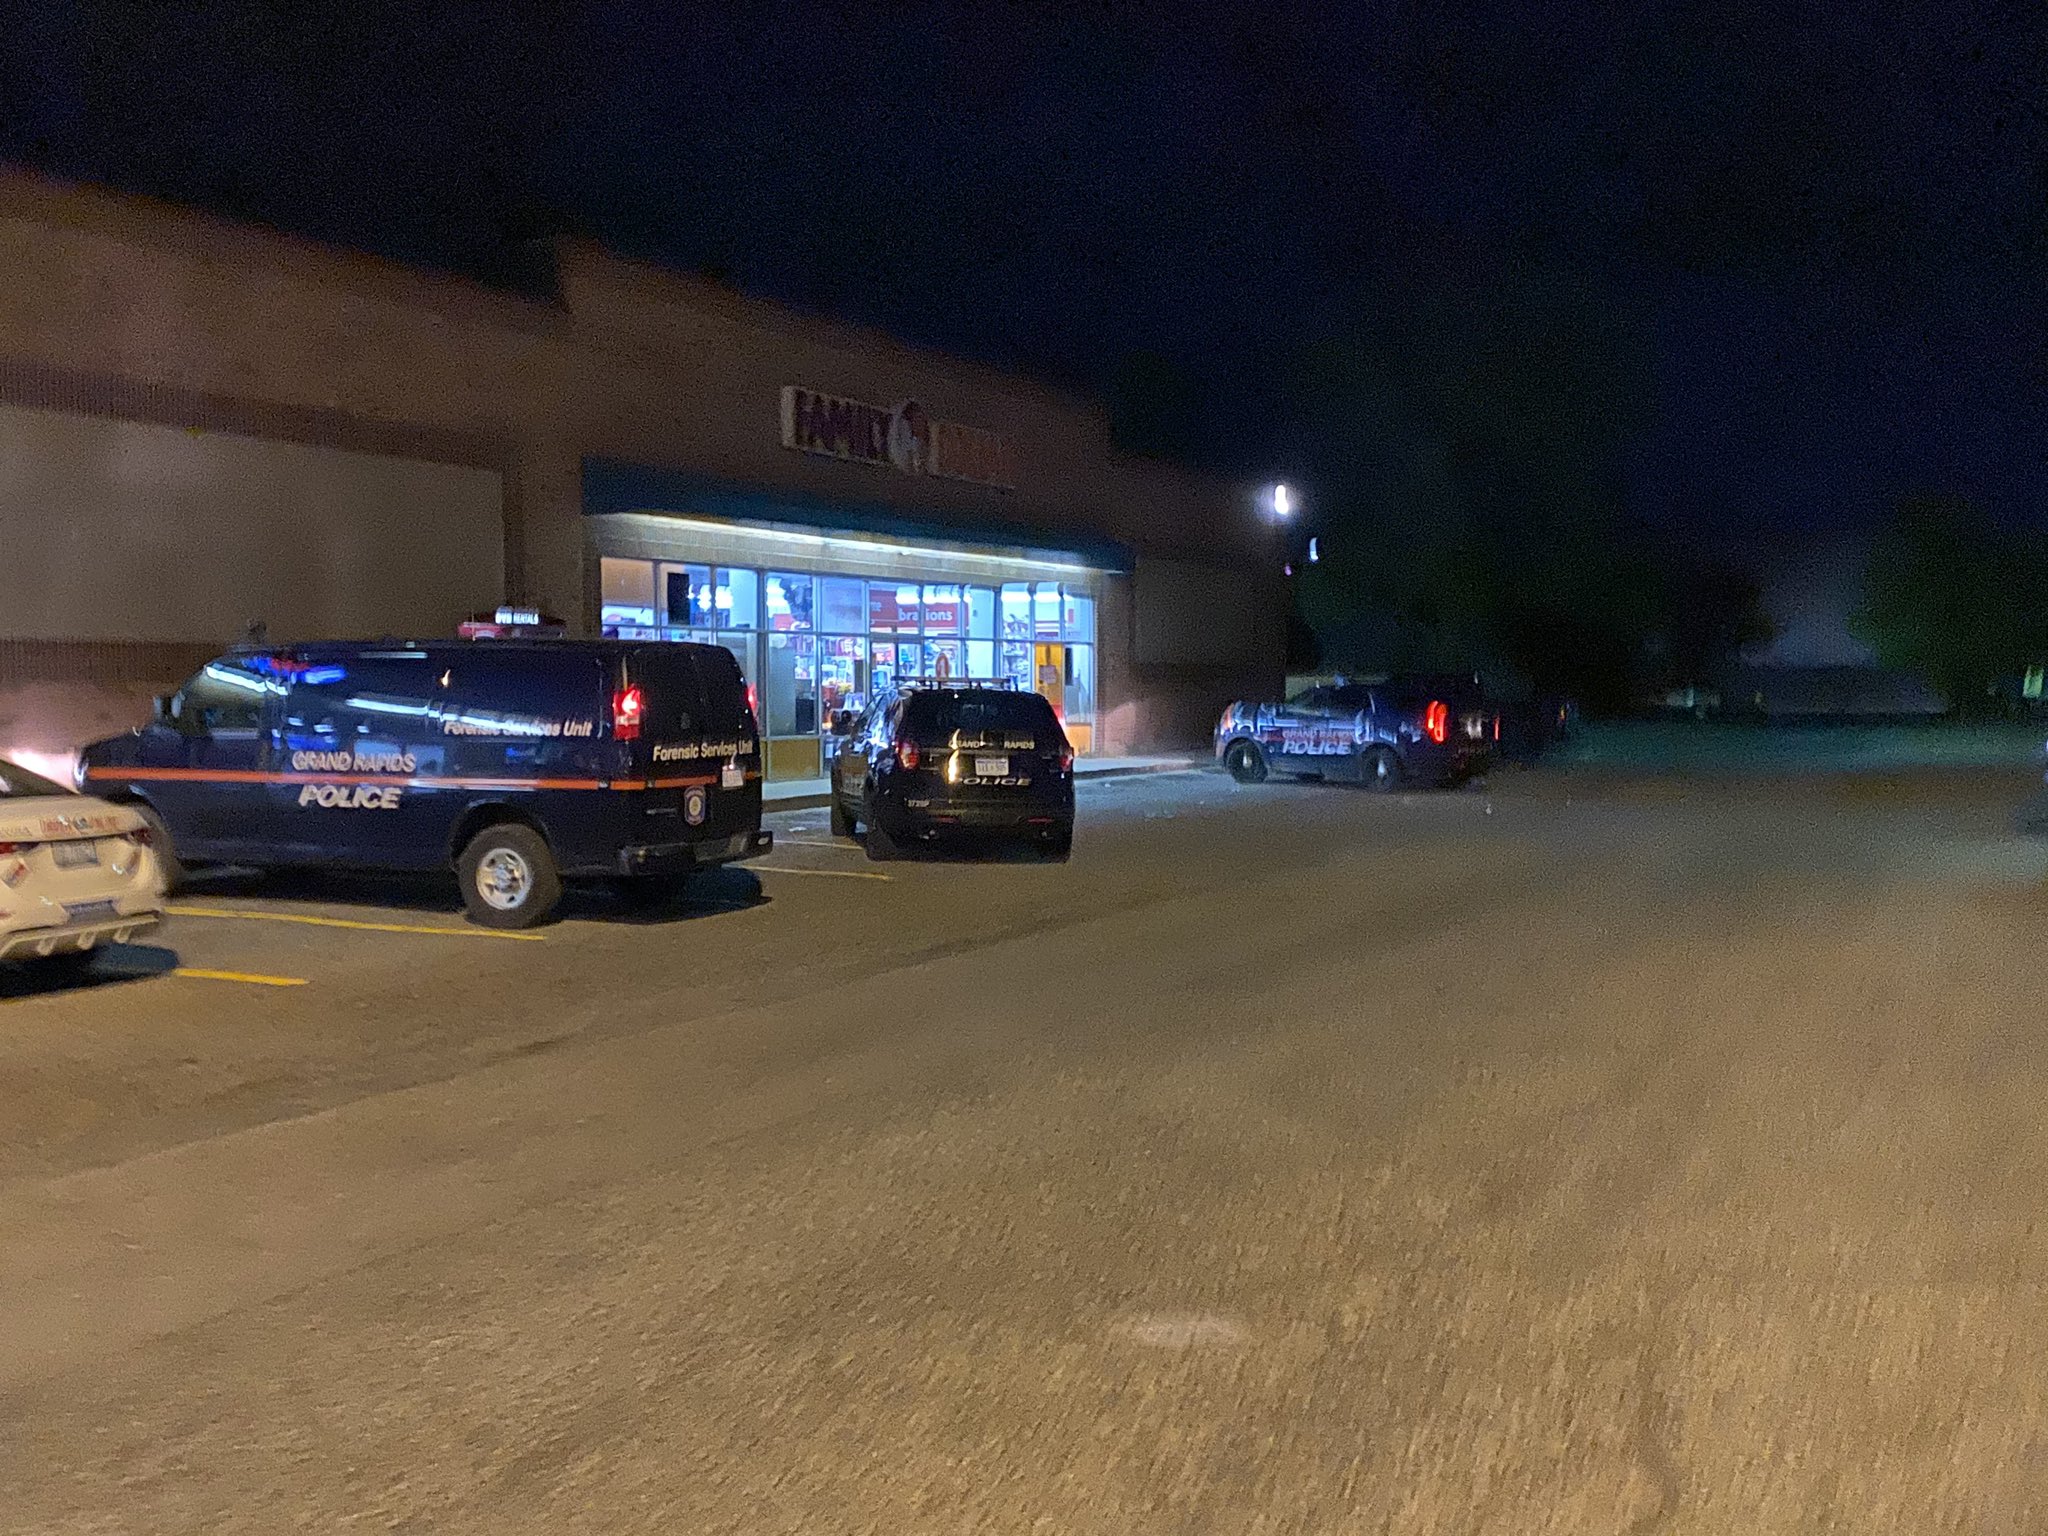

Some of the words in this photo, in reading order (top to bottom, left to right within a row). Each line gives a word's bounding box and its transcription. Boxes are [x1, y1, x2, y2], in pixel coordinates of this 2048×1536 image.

[563, 719, 593, 737] Unit
[653, 743, 699, 761] Forensic
[701, 742, 738, 758] Services
[1003, 740, 1035, 749] RAPIDS
[1282, 740, 1352, 754] POLICE
[292, 750, 352, 771] GRAND
[353, 752, 416, 772] RAPIDS
[298, 784, 401, 809] POLICE
